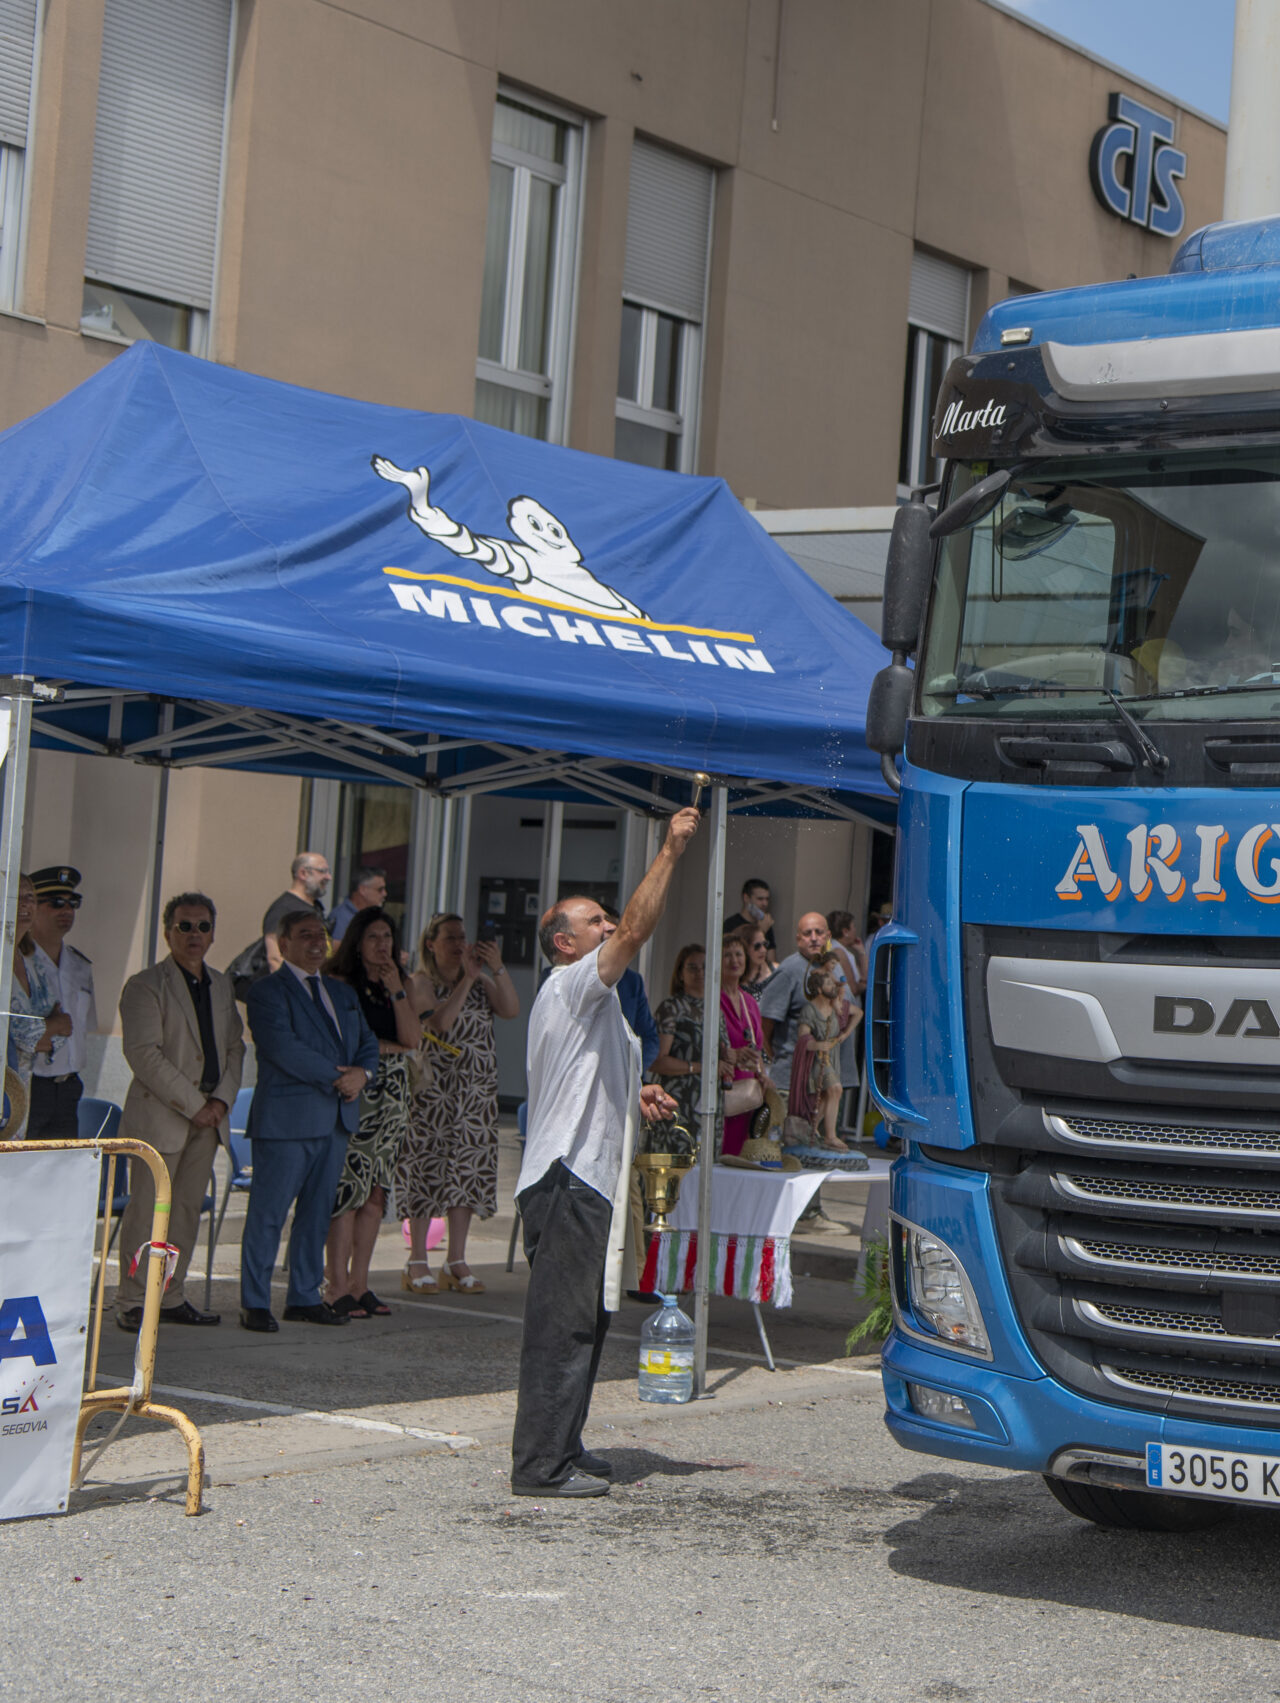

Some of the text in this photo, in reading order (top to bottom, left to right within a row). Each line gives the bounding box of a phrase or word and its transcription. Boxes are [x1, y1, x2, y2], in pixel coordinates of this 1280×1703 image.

[1090, 93, 1187, 237] CTS
[935, 398, 1006, 440] Marta
[388, 583, 775, 674] MICHELIN
[2, 1420, 48, 1436] SEGOVIA
[1169, 1451, 1249, 1492] 3056
